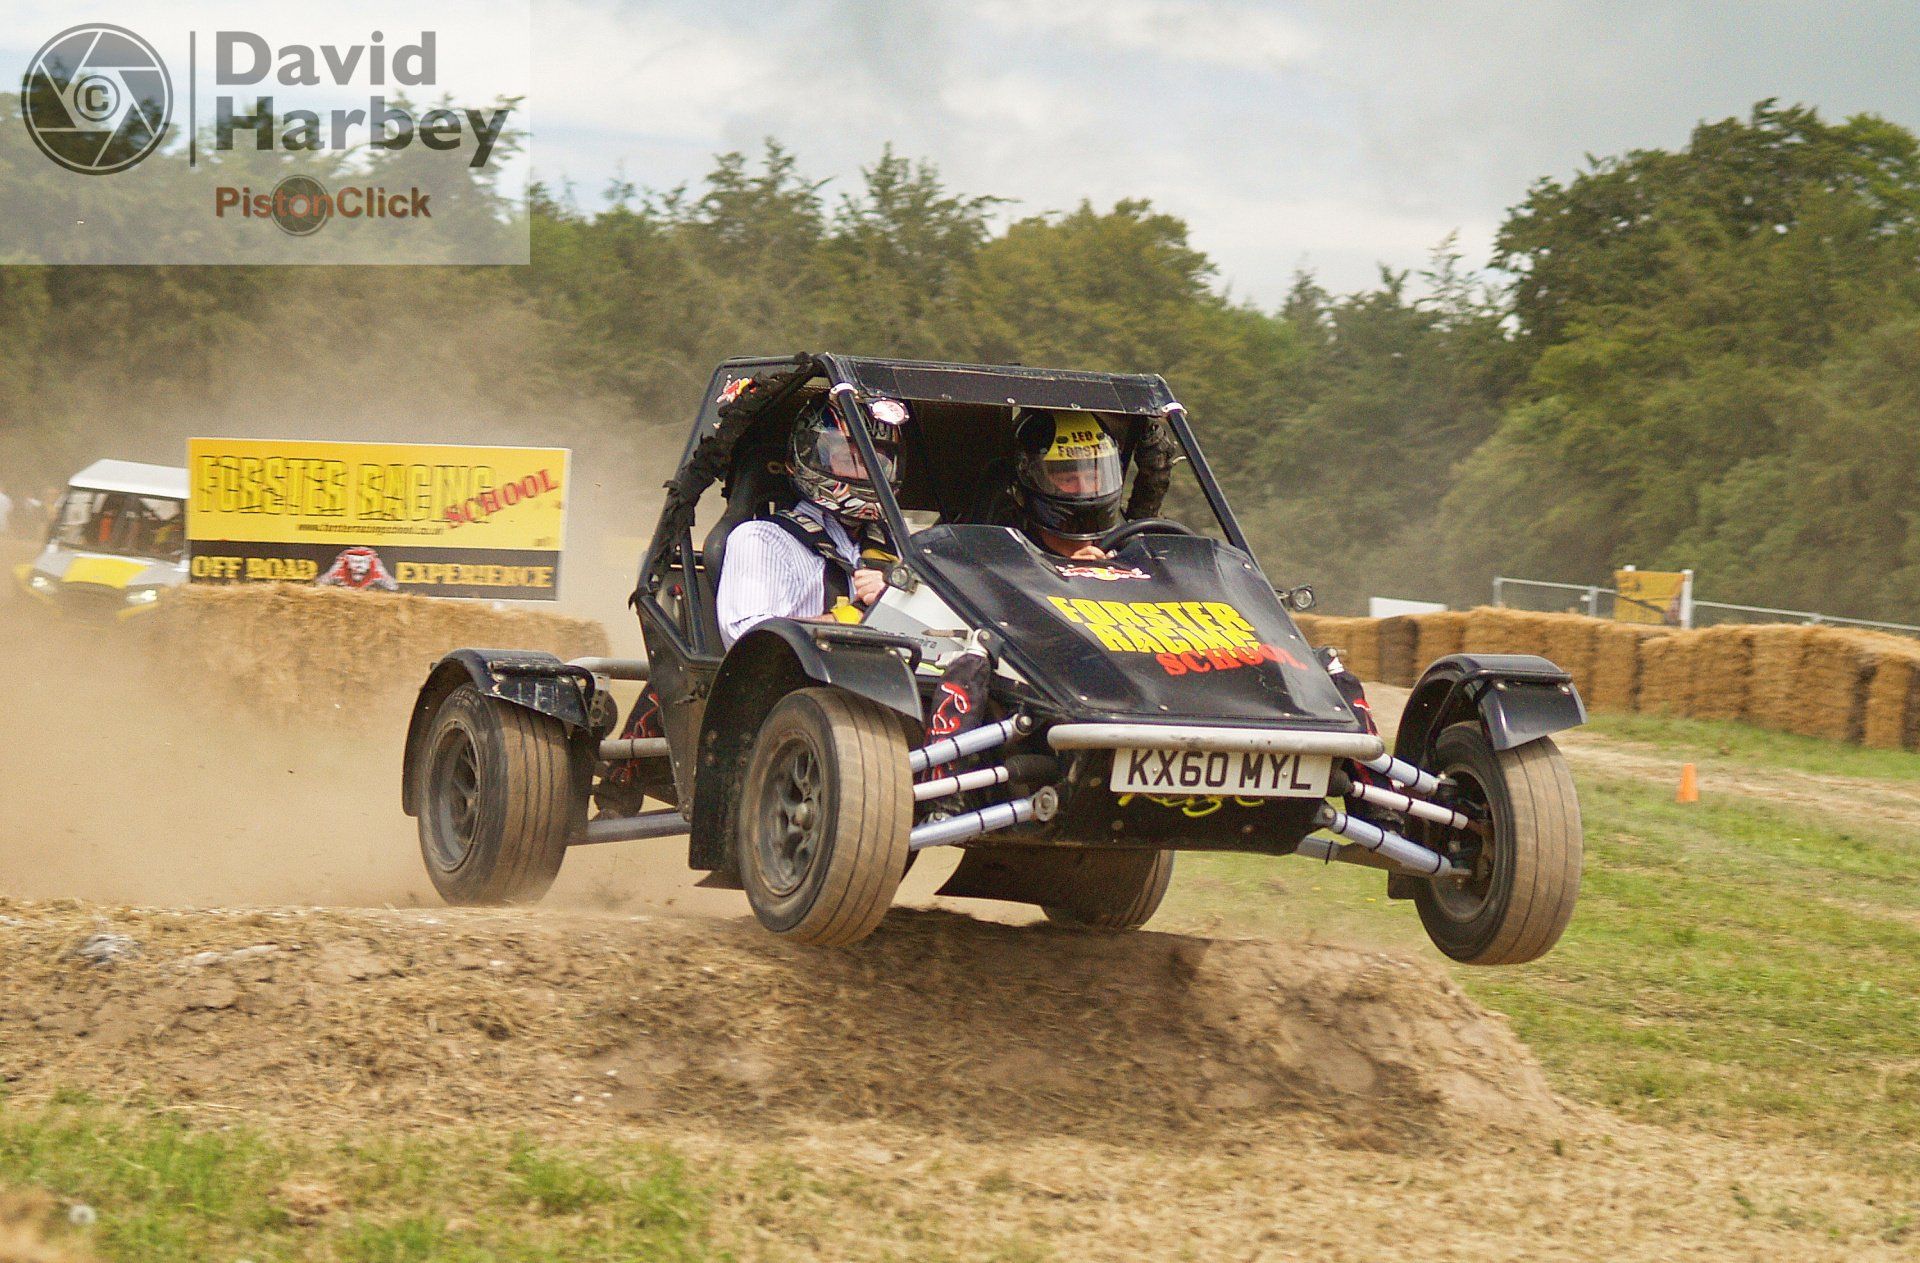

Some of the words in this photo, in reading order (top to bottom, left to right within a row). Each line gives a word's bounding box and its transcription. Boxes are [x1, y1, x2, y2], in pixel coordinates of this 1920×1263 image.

[443, 469, 559, 528] SCHOOL
[190, 556, 243, 580] OFF
[245, 557, 319, 582] ROAD
[396, 561, 555, 588] EXPERIENCE
[1047, 596, 1255, 630] FORSTER
[1155, 643, 1308, 676] SCHOOL
[1127, 749, 1229, 787] KX60
[1239, 752, 1311, 790] MYL
